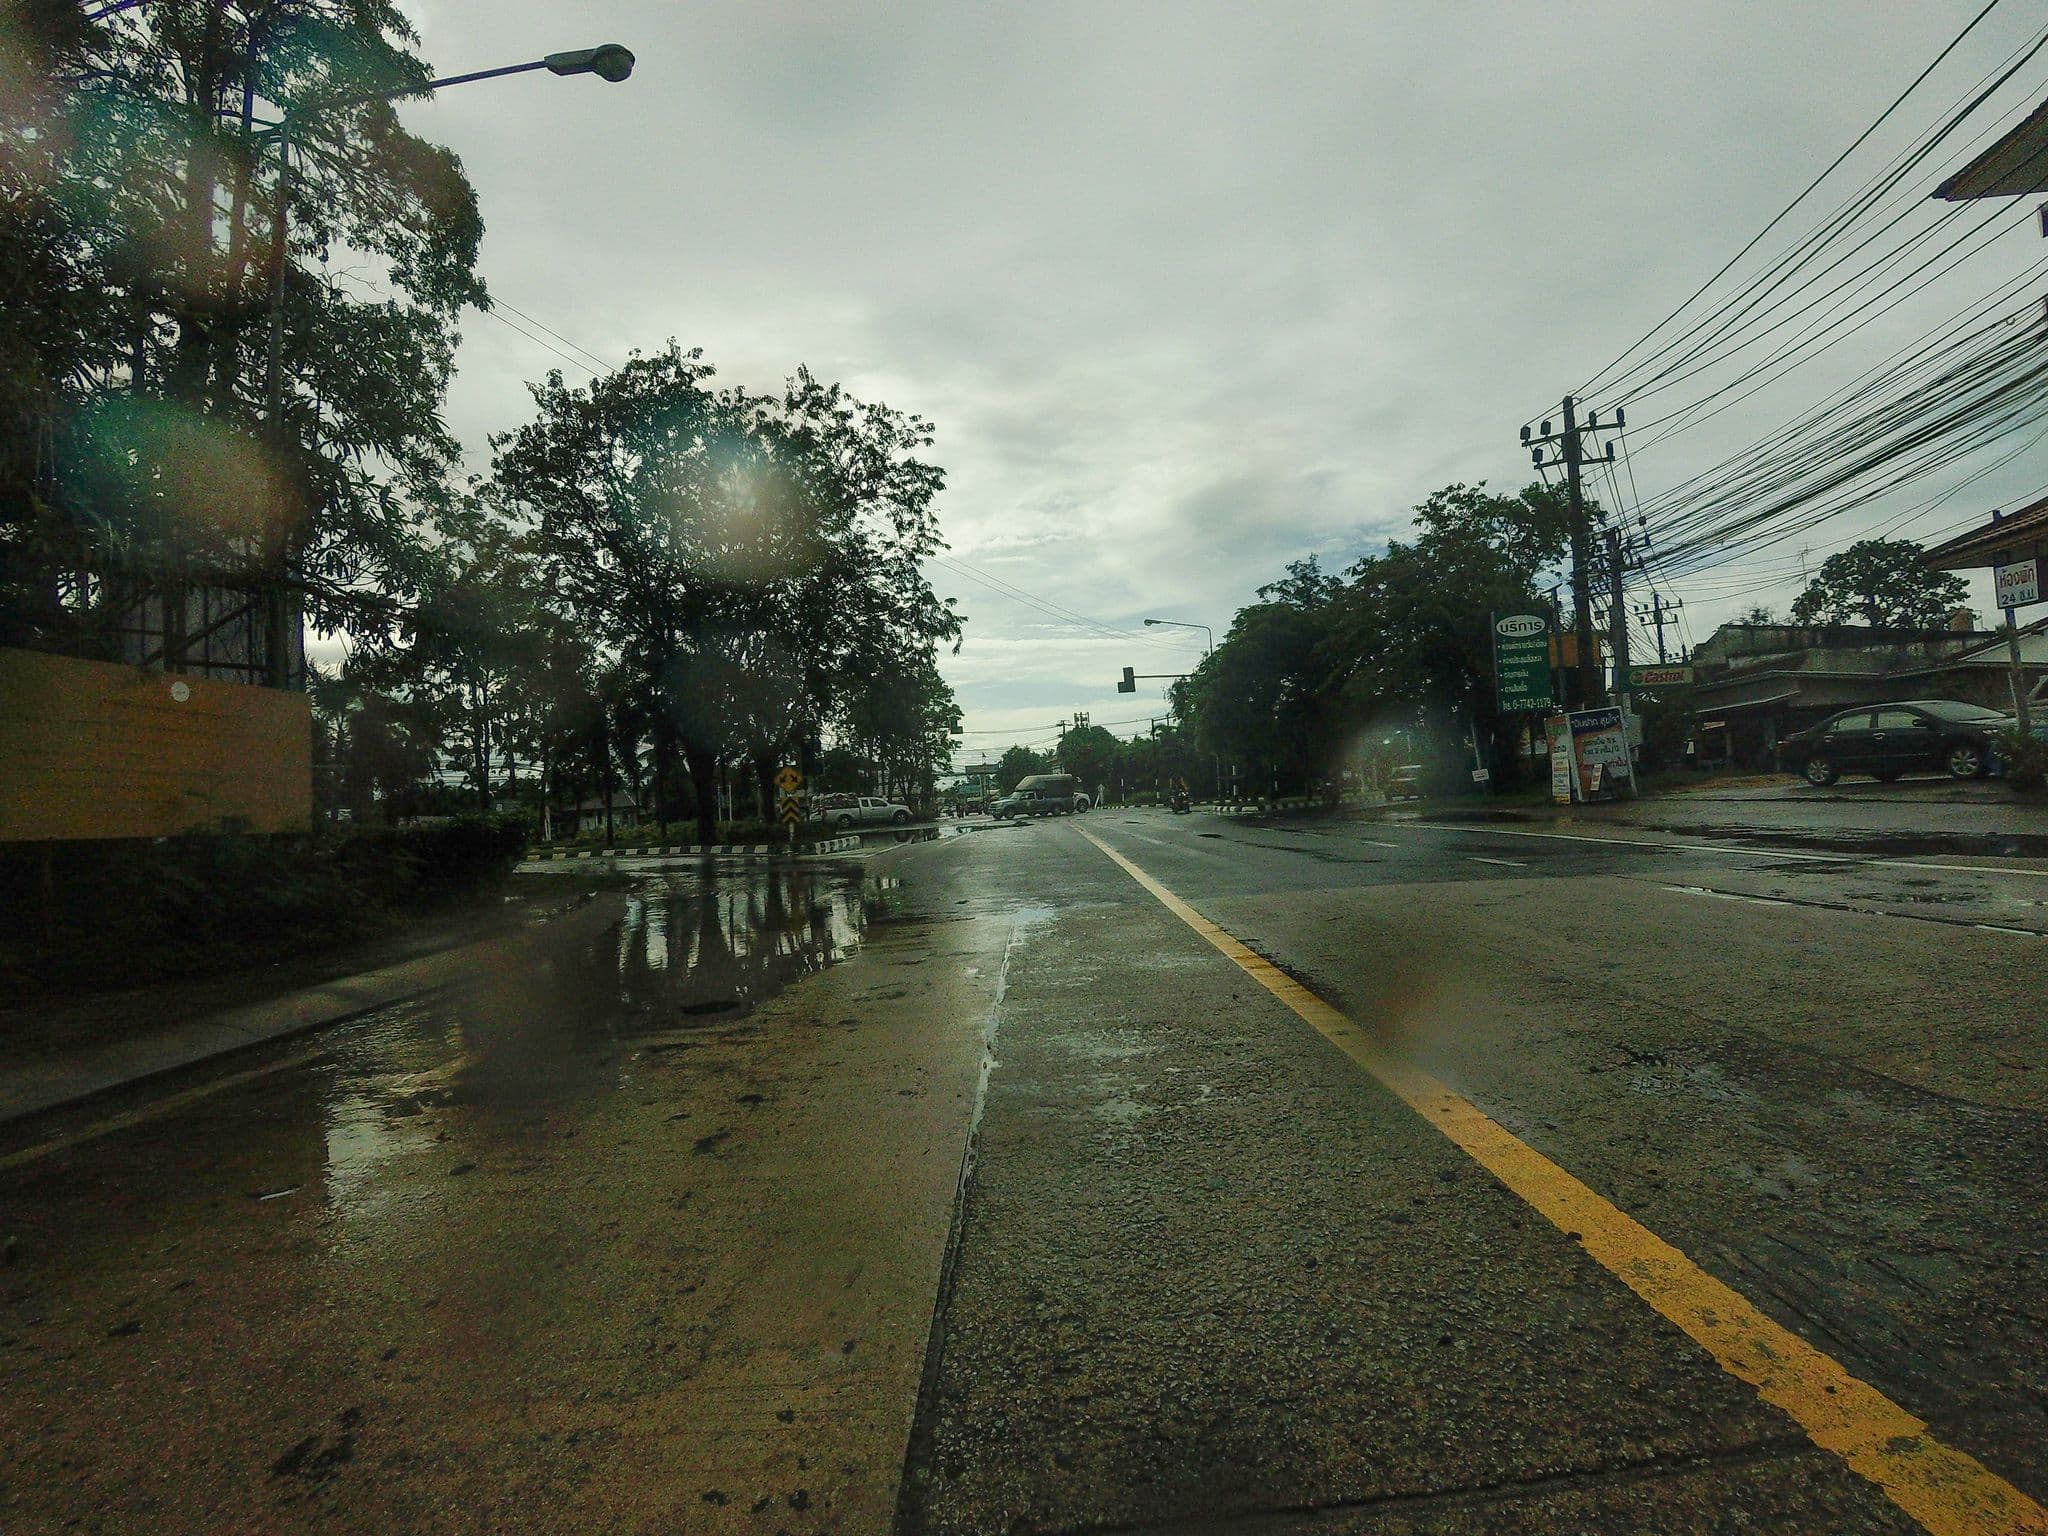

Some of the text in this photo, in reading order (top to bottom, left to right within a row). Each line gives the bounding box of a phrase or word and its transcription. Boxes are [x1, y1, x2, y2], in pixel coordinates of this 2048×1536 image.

[2001, 593, 2017, 604] 24
[1500, 620, 1542, 633] บริการ
[1645, 669, 1685, 683] Castrol
